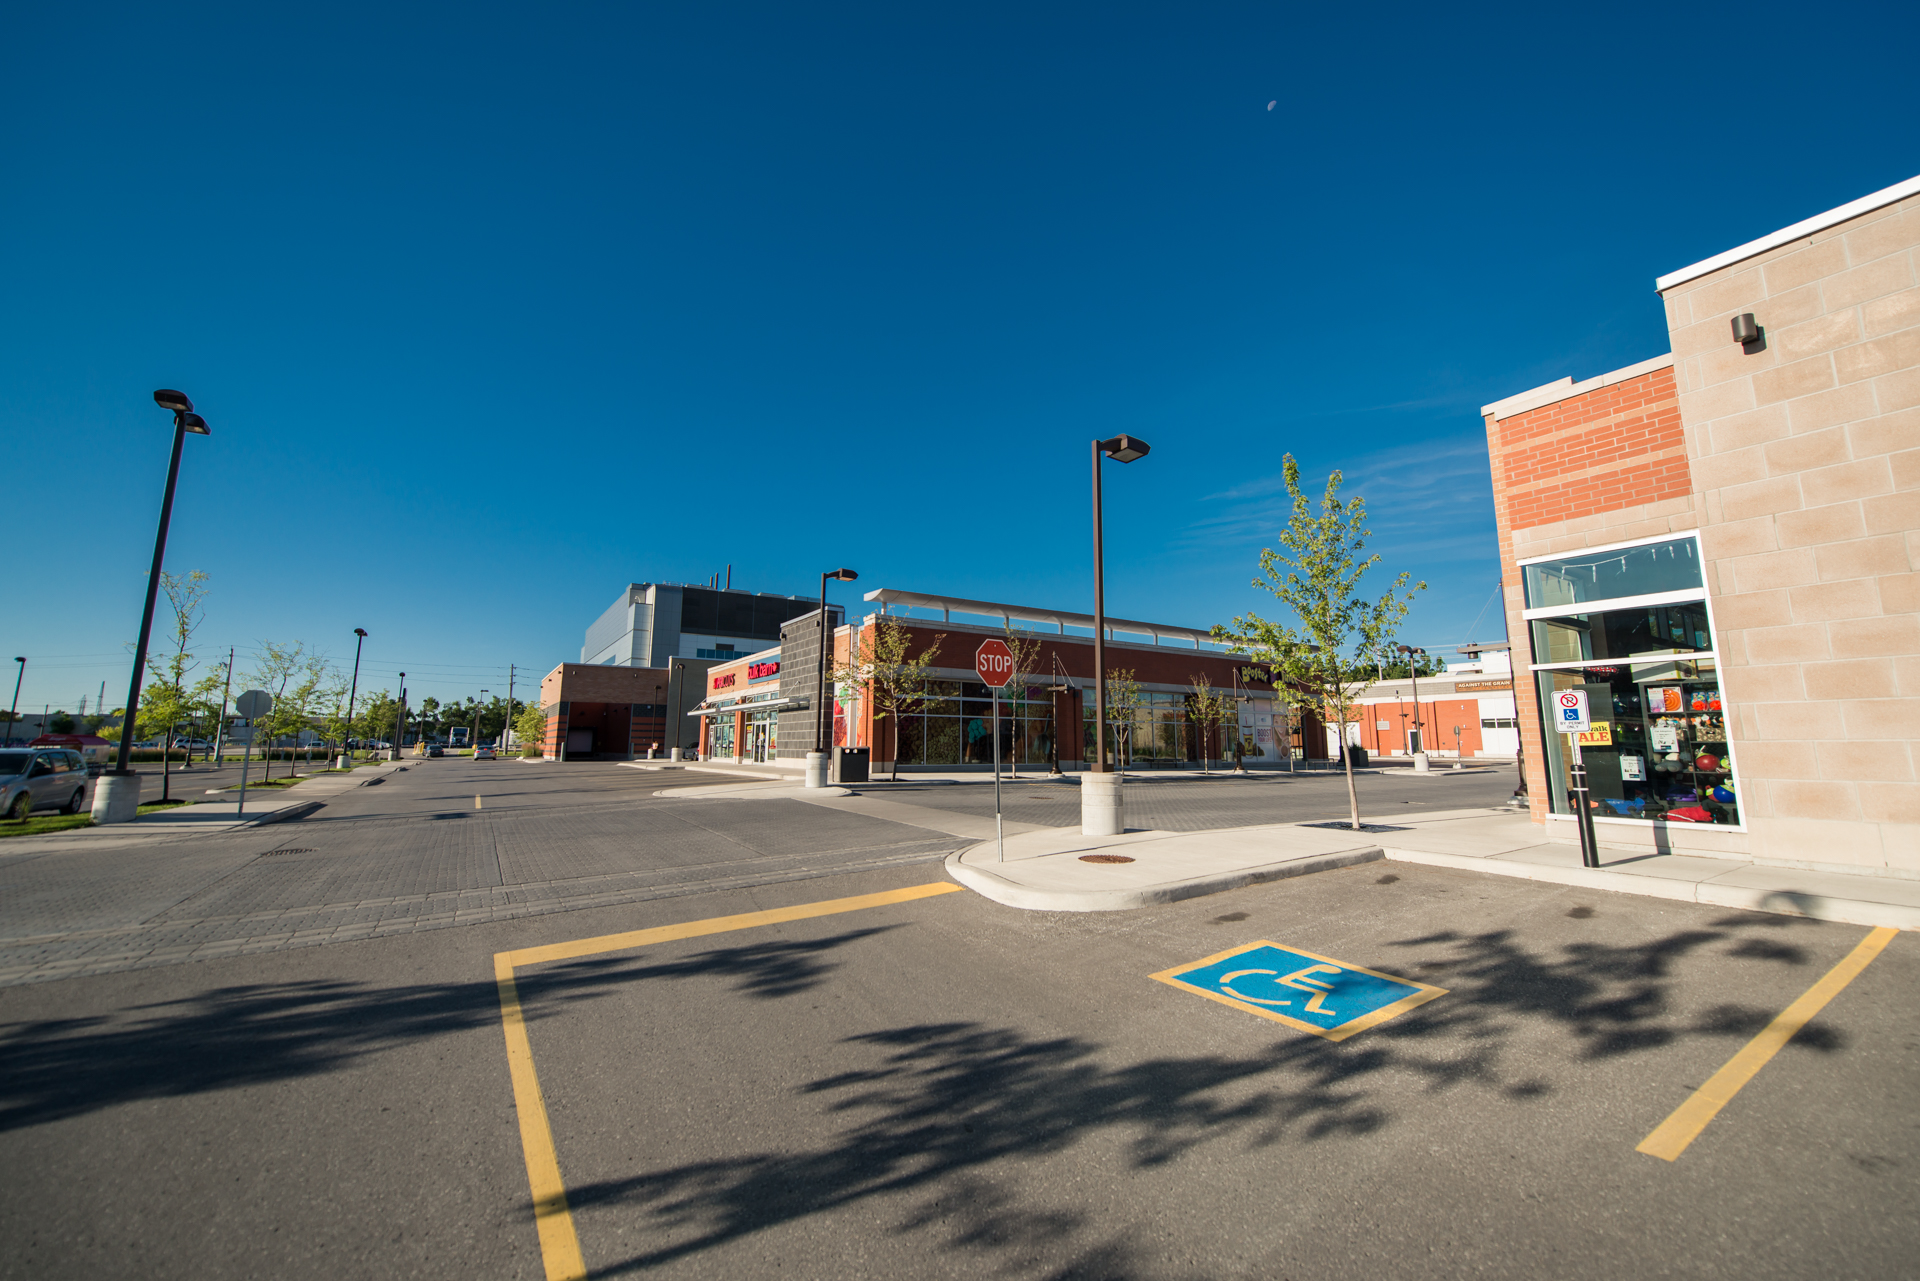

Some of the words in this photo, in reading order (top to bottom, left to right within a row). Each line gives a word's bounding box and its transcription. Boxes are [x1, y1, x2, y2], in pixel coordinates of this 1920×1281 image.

[980, 653, 1011, 672] STOP
[1241, 666, 1268, 683] Booster
[1257, 728, 1272, 737] BOOST
[1579, 732, 1610, 742] ALE
